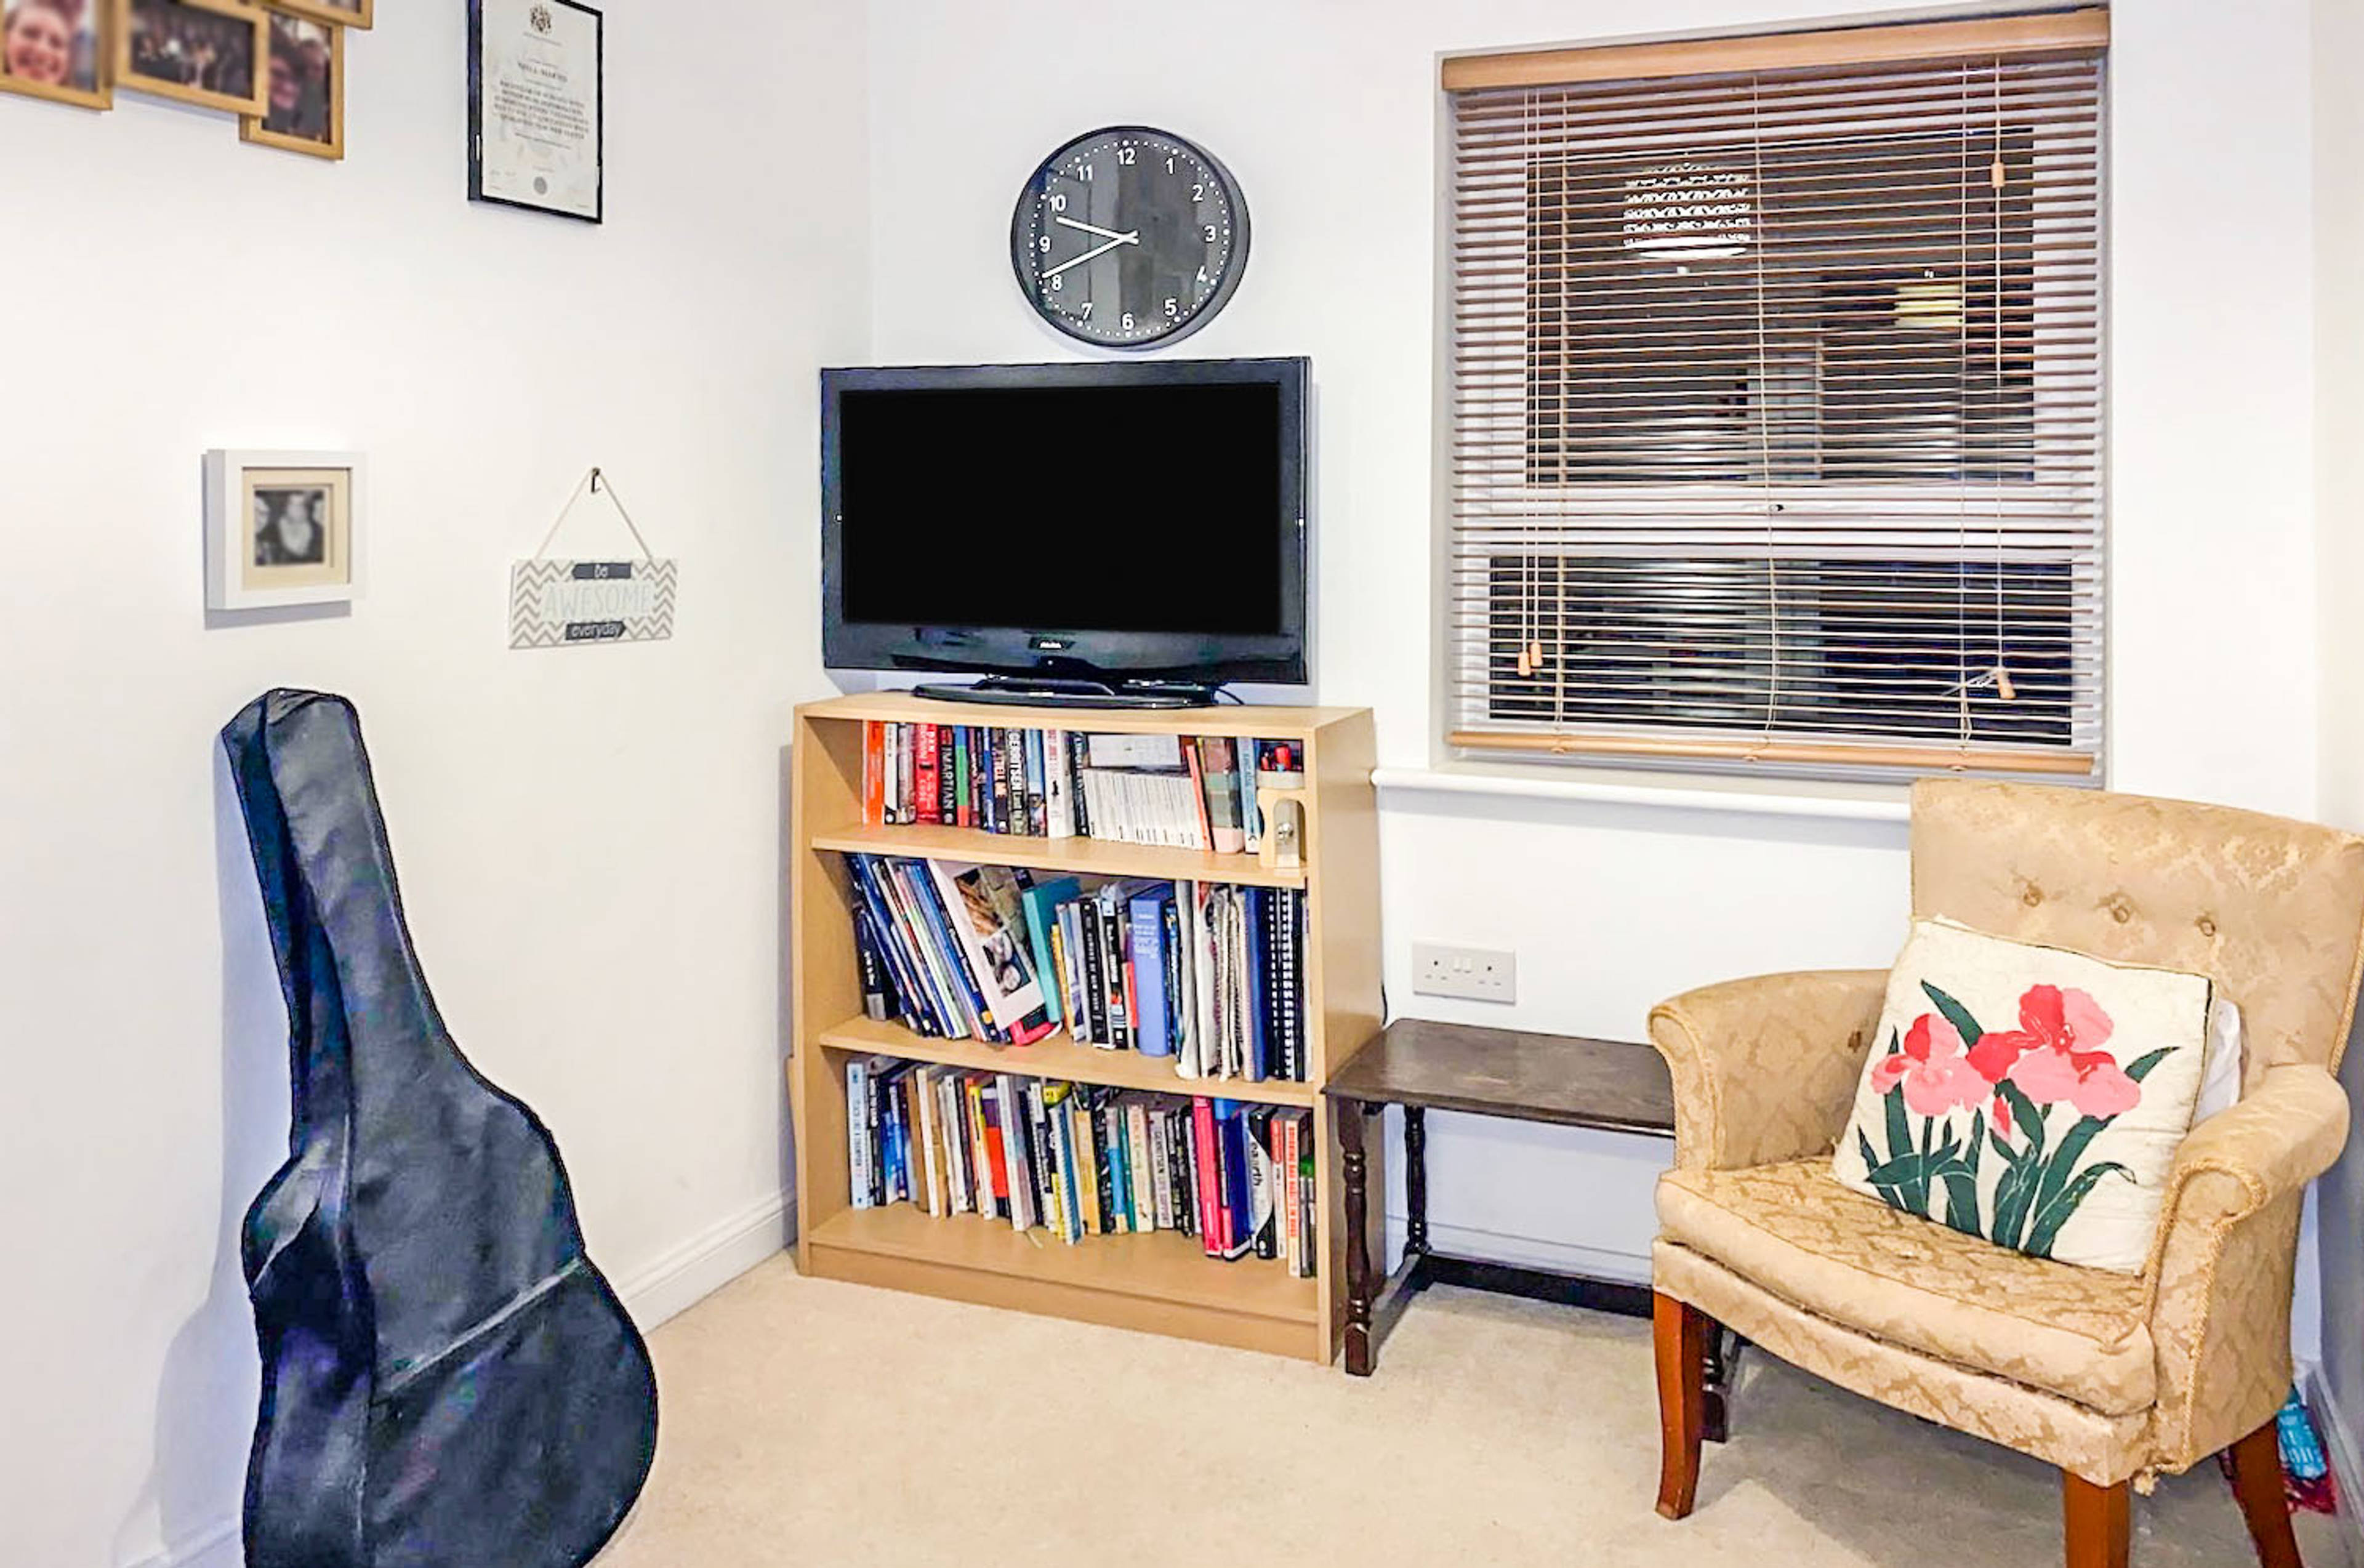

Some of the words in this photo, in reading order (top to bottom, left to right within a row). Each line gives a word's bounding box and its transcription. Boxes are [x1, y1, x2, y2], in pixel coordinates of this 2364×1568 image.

[1117, 148, 1136, 165] 12
[1077, 165, 1093, 180] 11
[1166, 158, 1175, 174] 1
[1192, 185, 1204, 201] 2
[1050, 195, 1066, 212] 10
[1204, 225, 1216, 242] 3
[1039, 236, 1050, 252] 9
[1196, 266, 1207, 281] 4
[1051, 275, 1062, 291] 8
[1081, 304, 1093, 319] 7
[1164, 299, 1176, 316] 5
[1122, 314, 1133, 329] 6
[544, 584, 653, 616] AWESOME
[571, 624, 621, 639] everyday
[942, 752, 955, 810] MARTIAN
